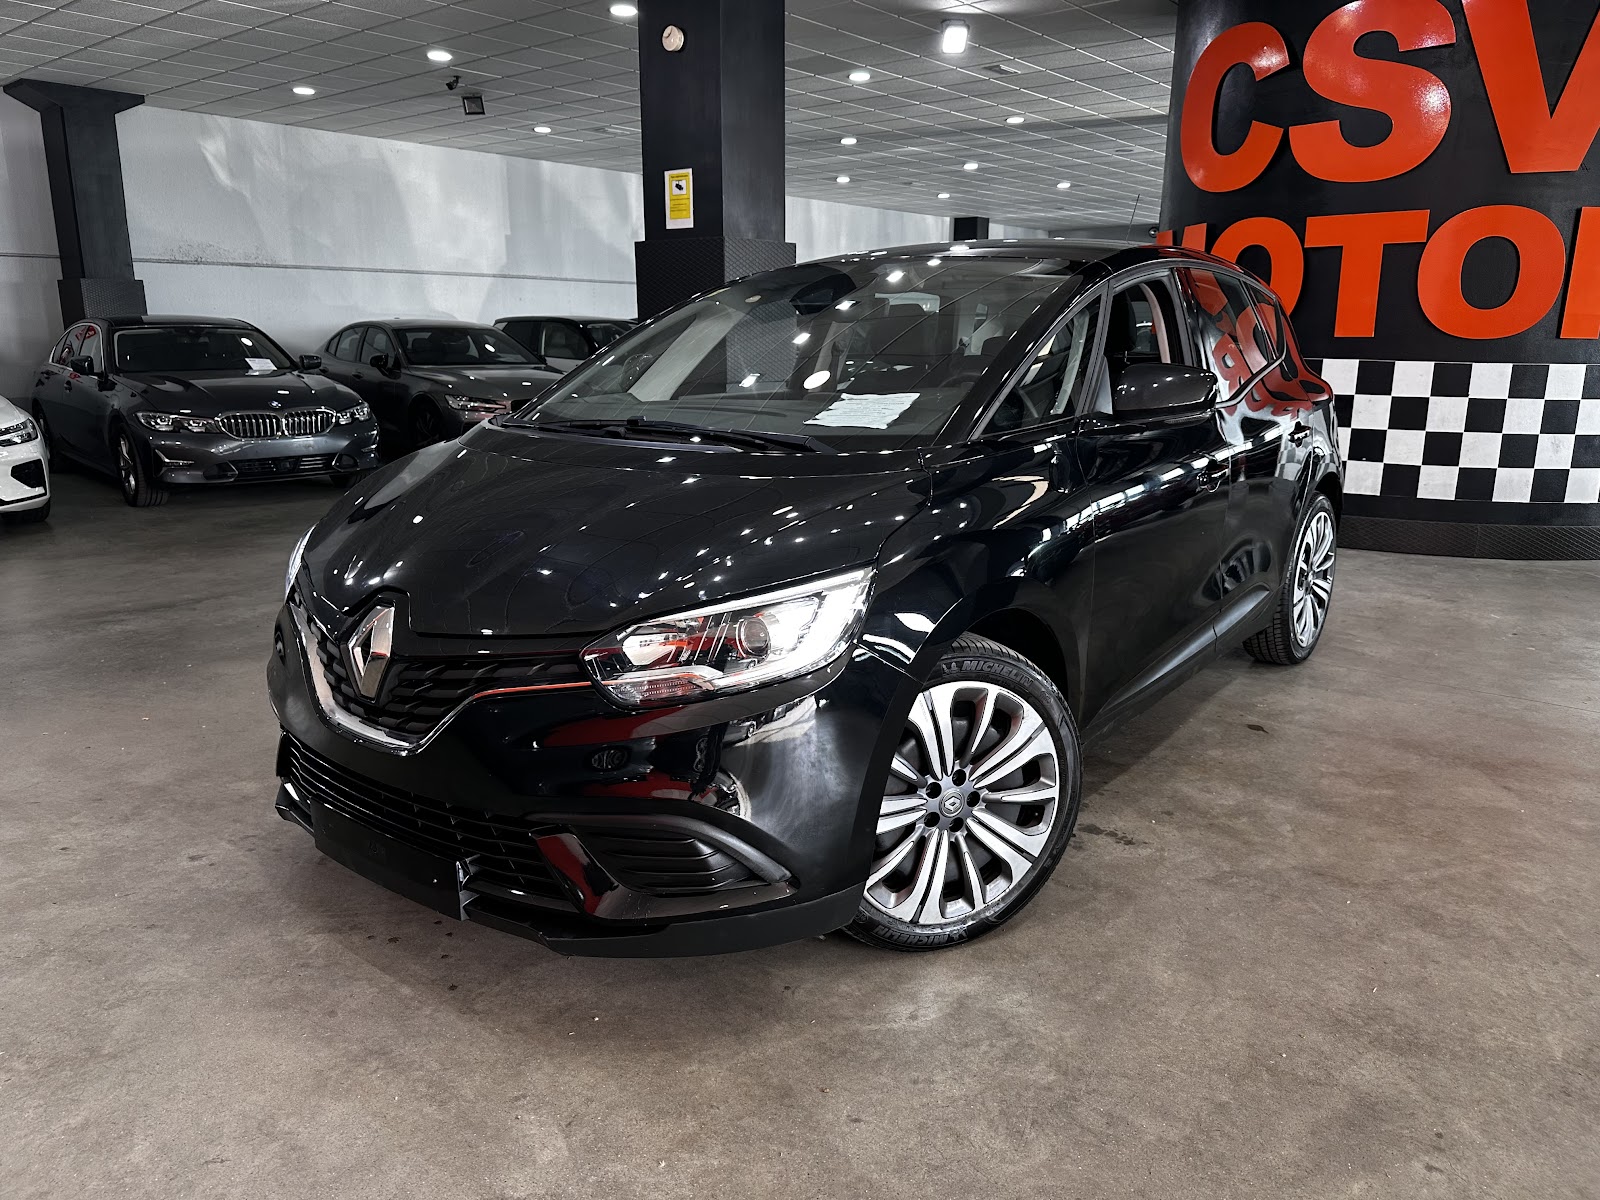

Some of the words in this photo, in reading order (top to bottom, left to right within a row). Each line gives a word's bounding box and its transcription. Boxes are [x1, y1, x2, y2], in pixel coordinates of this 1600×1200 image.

[1181, 0, 1600, 193] CSV
[1157, 205, 1600, 340] OTO
[961, 660, 1035, 687] MICHELIN
[873, 925, 949, 946] MICHELIN
